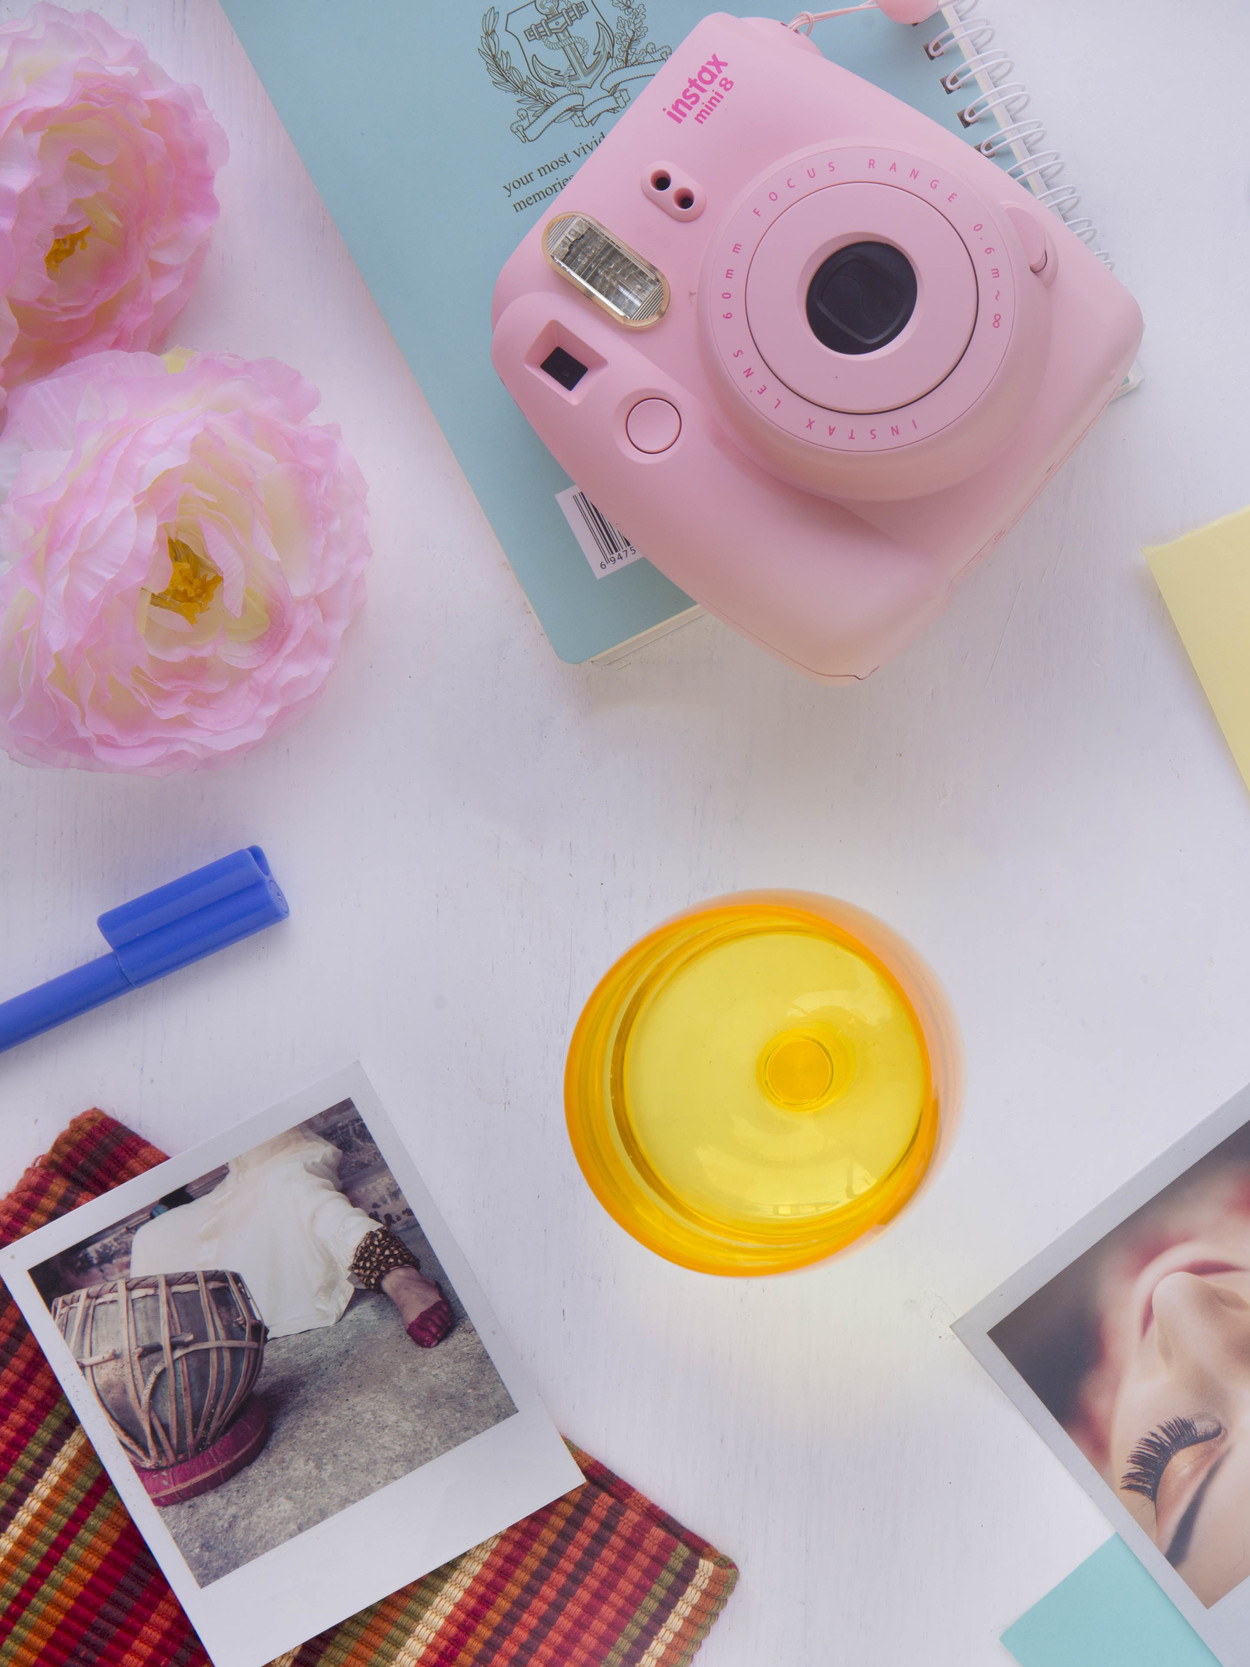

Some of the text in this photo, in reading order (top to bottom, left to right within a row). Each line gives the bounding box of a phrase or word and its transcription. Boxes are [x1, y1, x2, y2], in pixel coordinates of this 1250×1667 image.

[662, 53, 728, 124] instax
[694, 77, 734, 124] mini 8
[502, 173, 536, 197] your
[537, 152, 571, 178] most
[752, 161, 836, 217] FOCUS
[868, 158, 958, 203] RANGE
[732, 349, 782, 409] LENS
[805, 417, 918, 440] INSTAX
